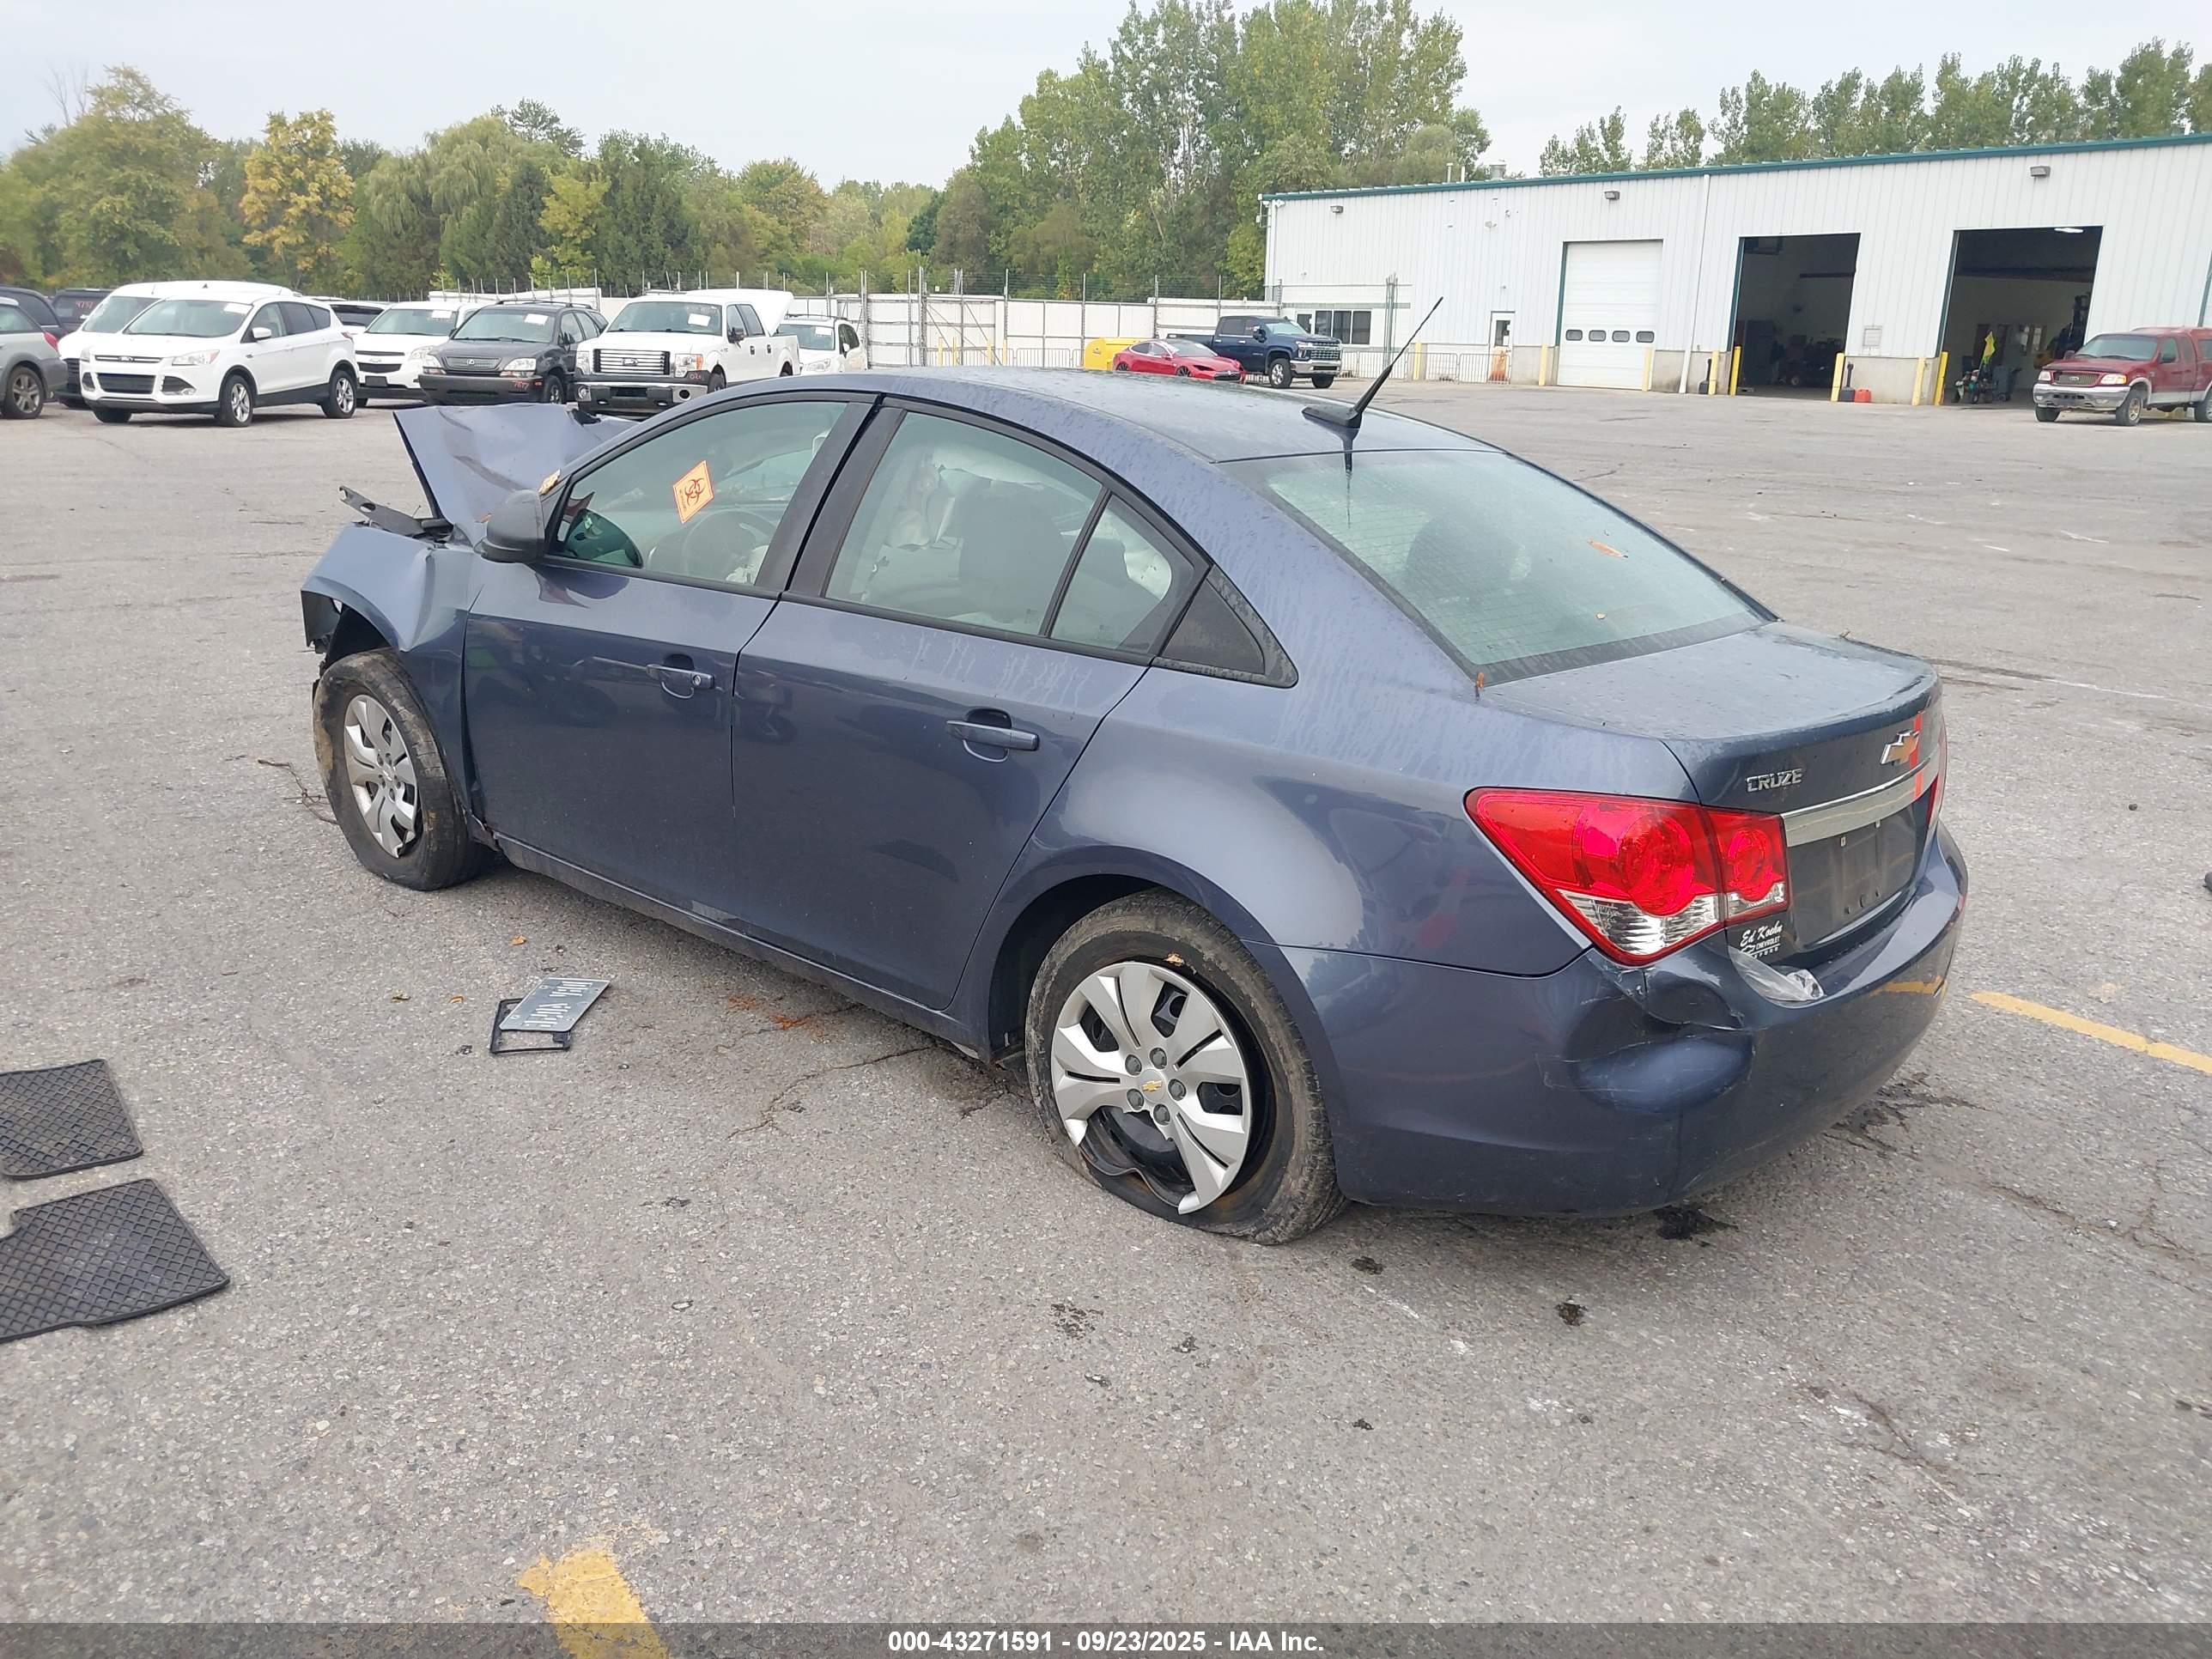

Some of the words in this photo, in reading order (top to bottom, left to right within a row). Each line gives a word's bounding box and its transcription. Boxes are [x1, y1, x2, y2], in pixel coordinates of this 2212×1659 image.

[1746, 768, 1802, 793] CRUZE
[1740, 928, 1757, 947] Ed
[1756, 935, 1781, 950] CHEVROLET
